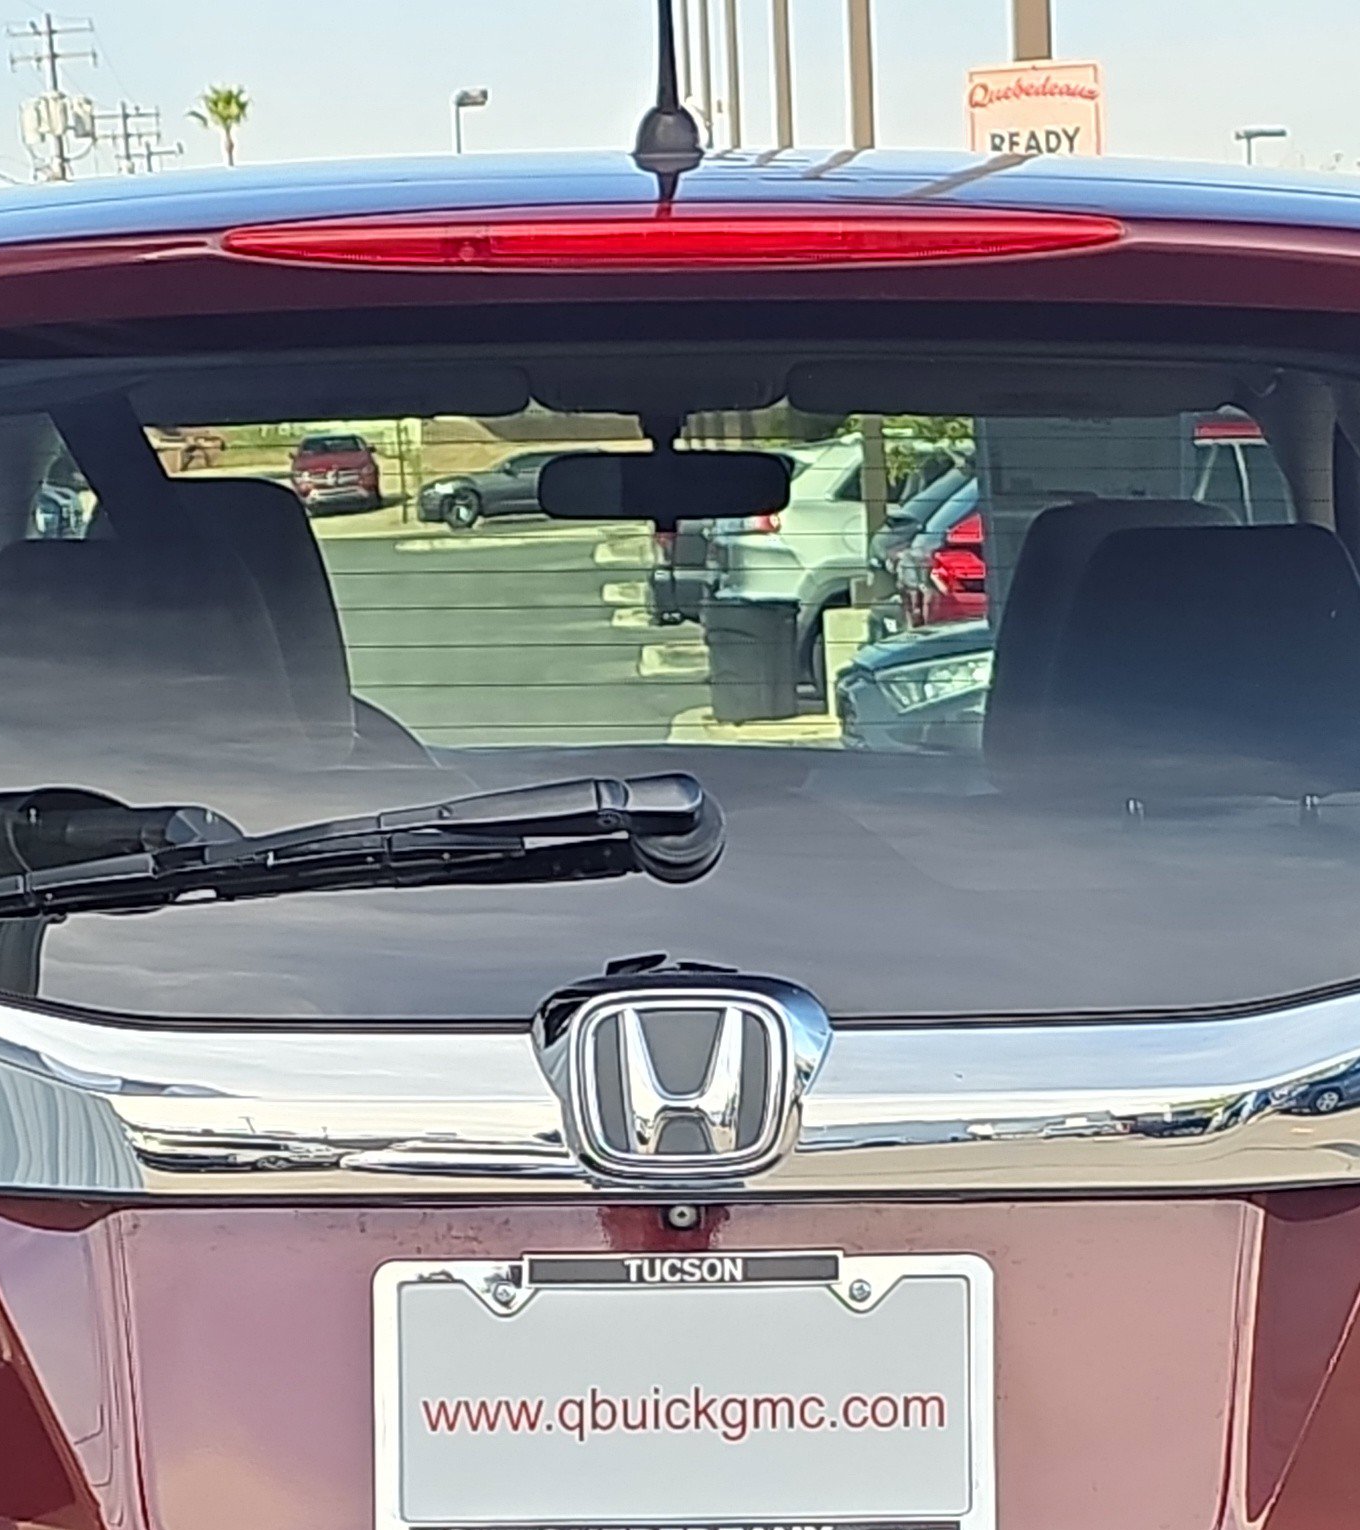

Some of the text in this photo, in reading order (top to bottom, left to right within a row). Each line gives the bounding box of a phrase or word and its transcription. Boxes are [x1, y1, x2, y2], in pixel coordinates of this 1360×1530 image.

[990, 126, 1081, 155] READY
[623, 1257, 744, 1283] TUCSON
[420, 1385, 948, 1443] www.qbuickgmc.com
